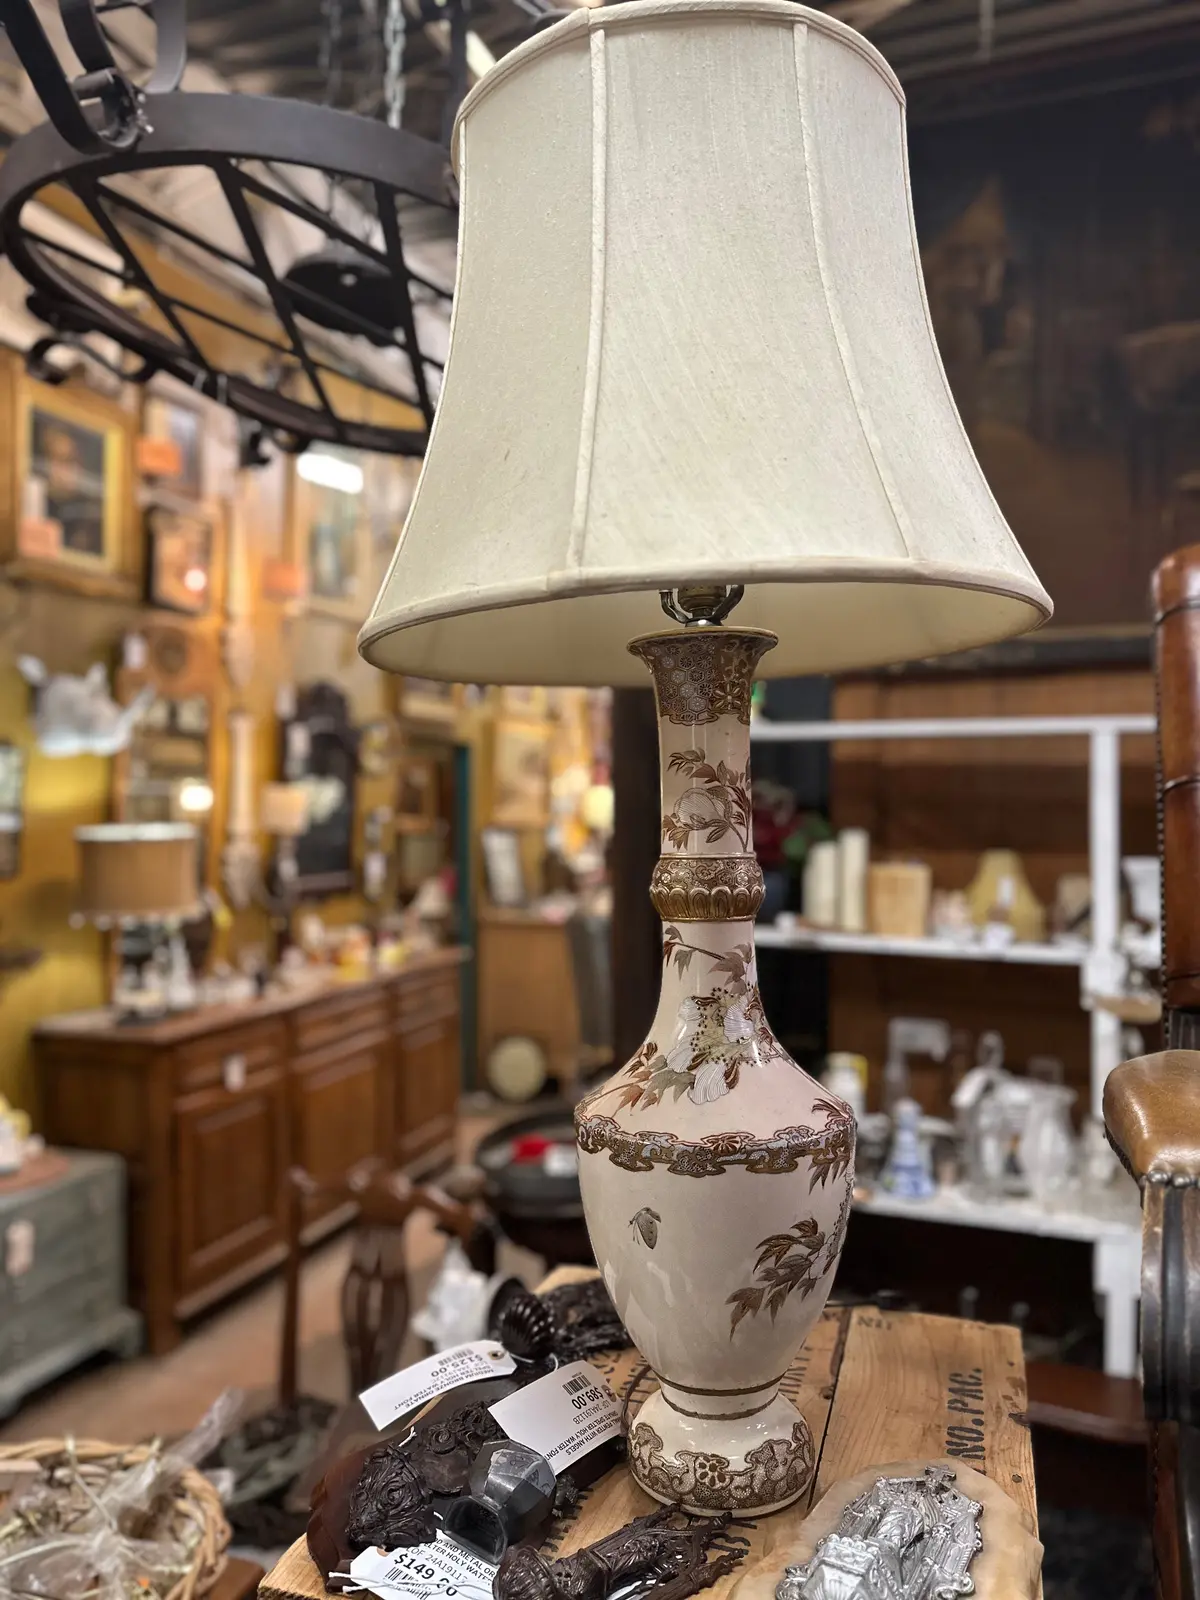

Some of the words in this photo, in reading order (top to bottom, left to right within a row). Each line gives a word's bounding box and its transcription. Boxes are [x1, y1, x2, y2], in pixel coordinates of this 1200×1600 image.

[431, 1355, 483, 1377] $125.00
[393, 1396, 412, 1410] FONT
[572, 1385, 604, 1410] $89.00
[574, 1426, 588, 1439] HOLY
[584, 1430, 598, 1443] WITH
[557, 1435, 576, 1452] WATER
[565, 1438, 586, 1456] ANGELS
[544, 1449, 559, 1462] FONT
[442, 1541, 459, 1554] AND
[457, 1550, 484, 1570] METAL
[445, 1551, 466, 1567] HOLY
